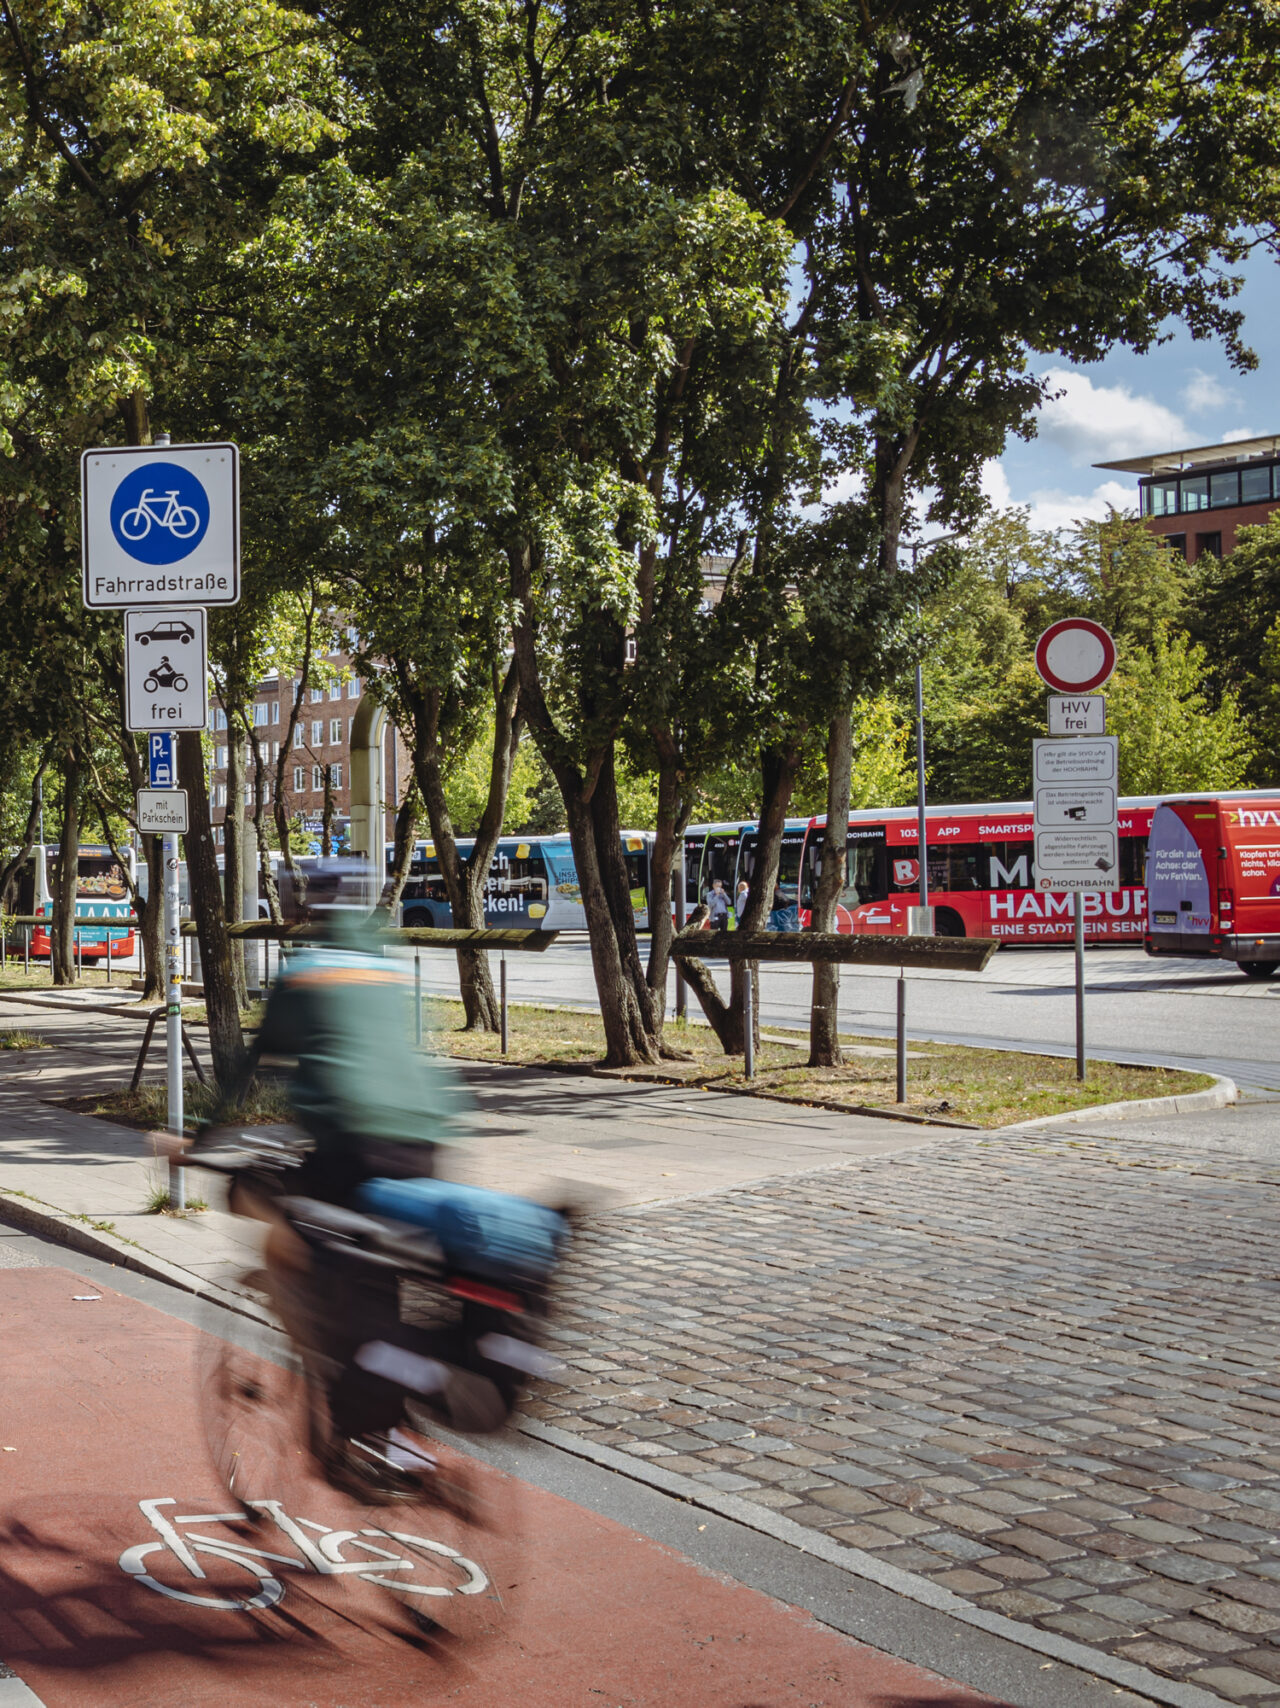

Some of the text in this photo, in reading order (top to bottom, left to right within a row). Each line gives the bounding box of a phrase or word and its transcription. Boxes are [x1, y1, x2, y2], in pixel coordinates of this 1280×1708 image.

[95, 573, 227, 593] Fahrradstraße
[151, 703, 182, 719] frei
[1061, 701, 1090, 713] HVV
[1065, 717, 1087, 729] frei
[152, 736, 163, 758] P
[156, 800, 168, 810] mit
[142, 812, 184, 823] Parkschein
[847, 831, 884, 839] OCHBAHN
[937, 827, 960, 837] APP
[1240, 850, 1268, 859] Klopfen
[1181, 861, 1198, 870] der
[1155, 872, 1169, 880] hvv
[1242, 869, 1267, 877] schon.
[991, 923, 1025, 935] EINE
[1028, 922, 1075, 934] STADT
[1083, 922, 1108, 933] EIN
